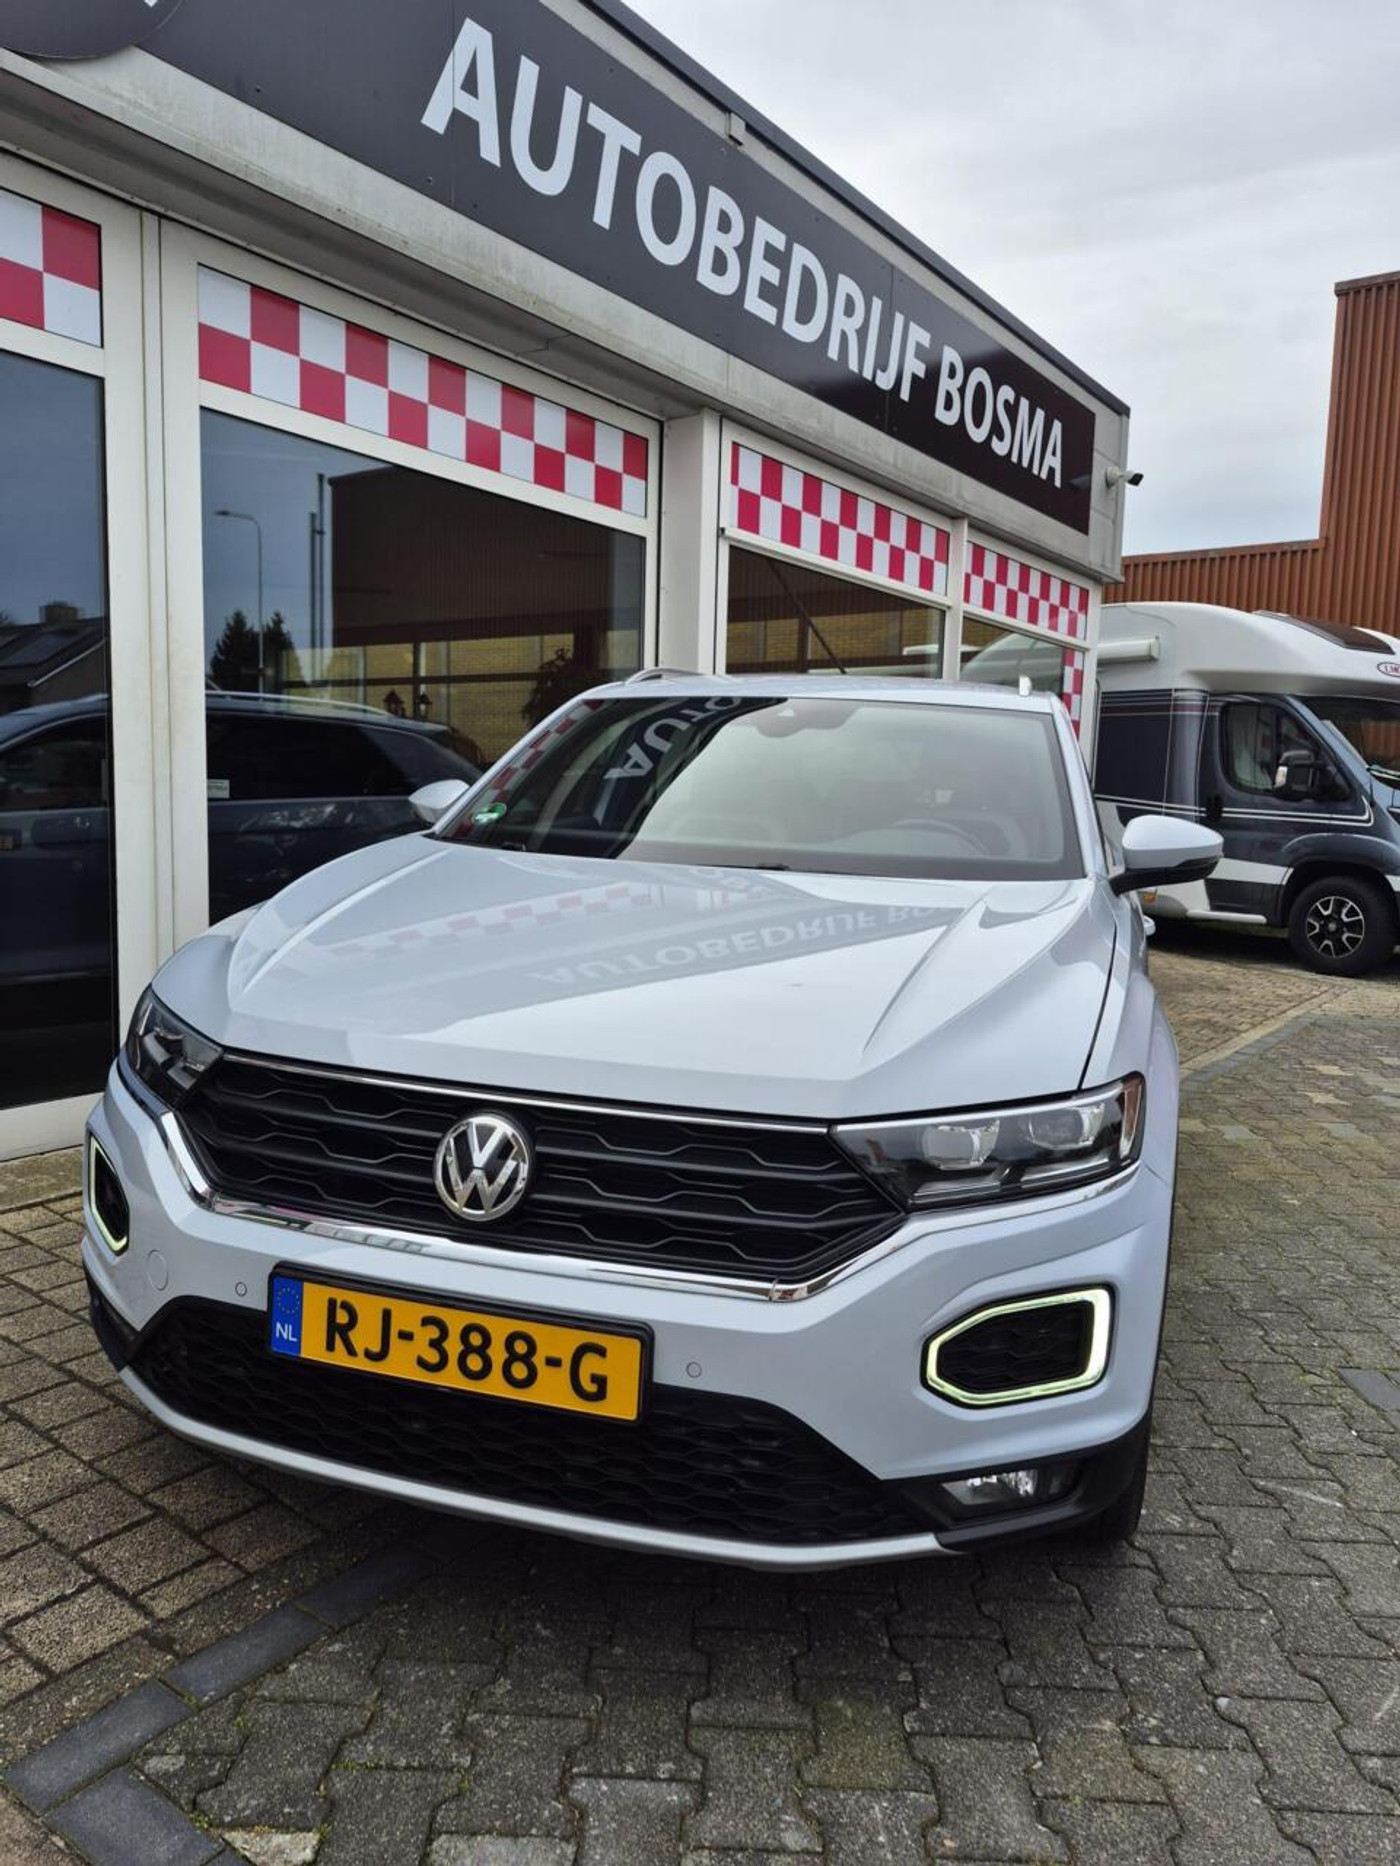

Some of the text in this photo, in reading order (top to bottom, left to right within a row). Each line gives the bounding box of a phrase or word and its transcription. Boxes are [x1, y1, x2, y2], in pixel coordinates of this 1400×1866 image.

[421, 17, 1063, 489] AUTOBEDRIJF BOSMA
[436, 1116, 529, 1221] VW
[275, 1321, 297, 1342] NL
[325, 1296, 608, 1402] RJ-388-G
